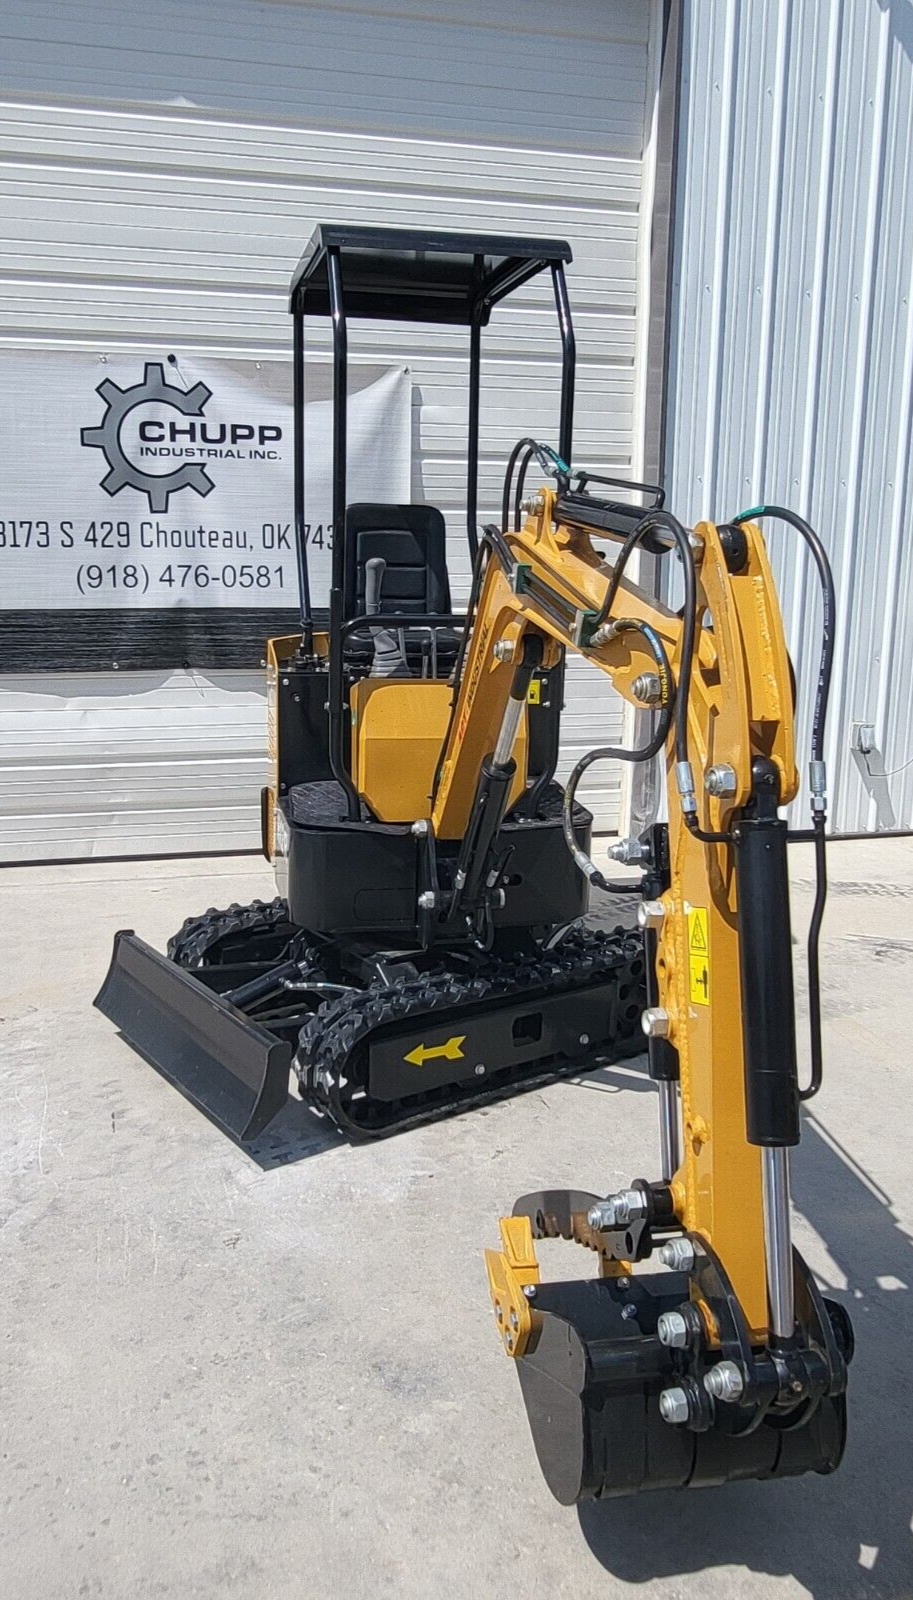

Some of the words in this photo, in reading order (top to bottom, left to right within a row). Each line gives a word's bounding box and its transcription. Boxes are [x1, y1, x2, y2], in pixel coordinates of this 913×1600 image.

[138, 420, 283, 446] CHUPP
[139, 446, 246, 460] INDUSTRIAL
[249, 450, 282, 461] INC.
[59, 521, 74, 548] S
[84, 521, 130, 548] 429
[140, 521, 254, 552] Chouteau,
[262, 523, 292, 550] OK
[76, 564, 150, 595] (918)
[159, 564, 284, 589] 476-0581
